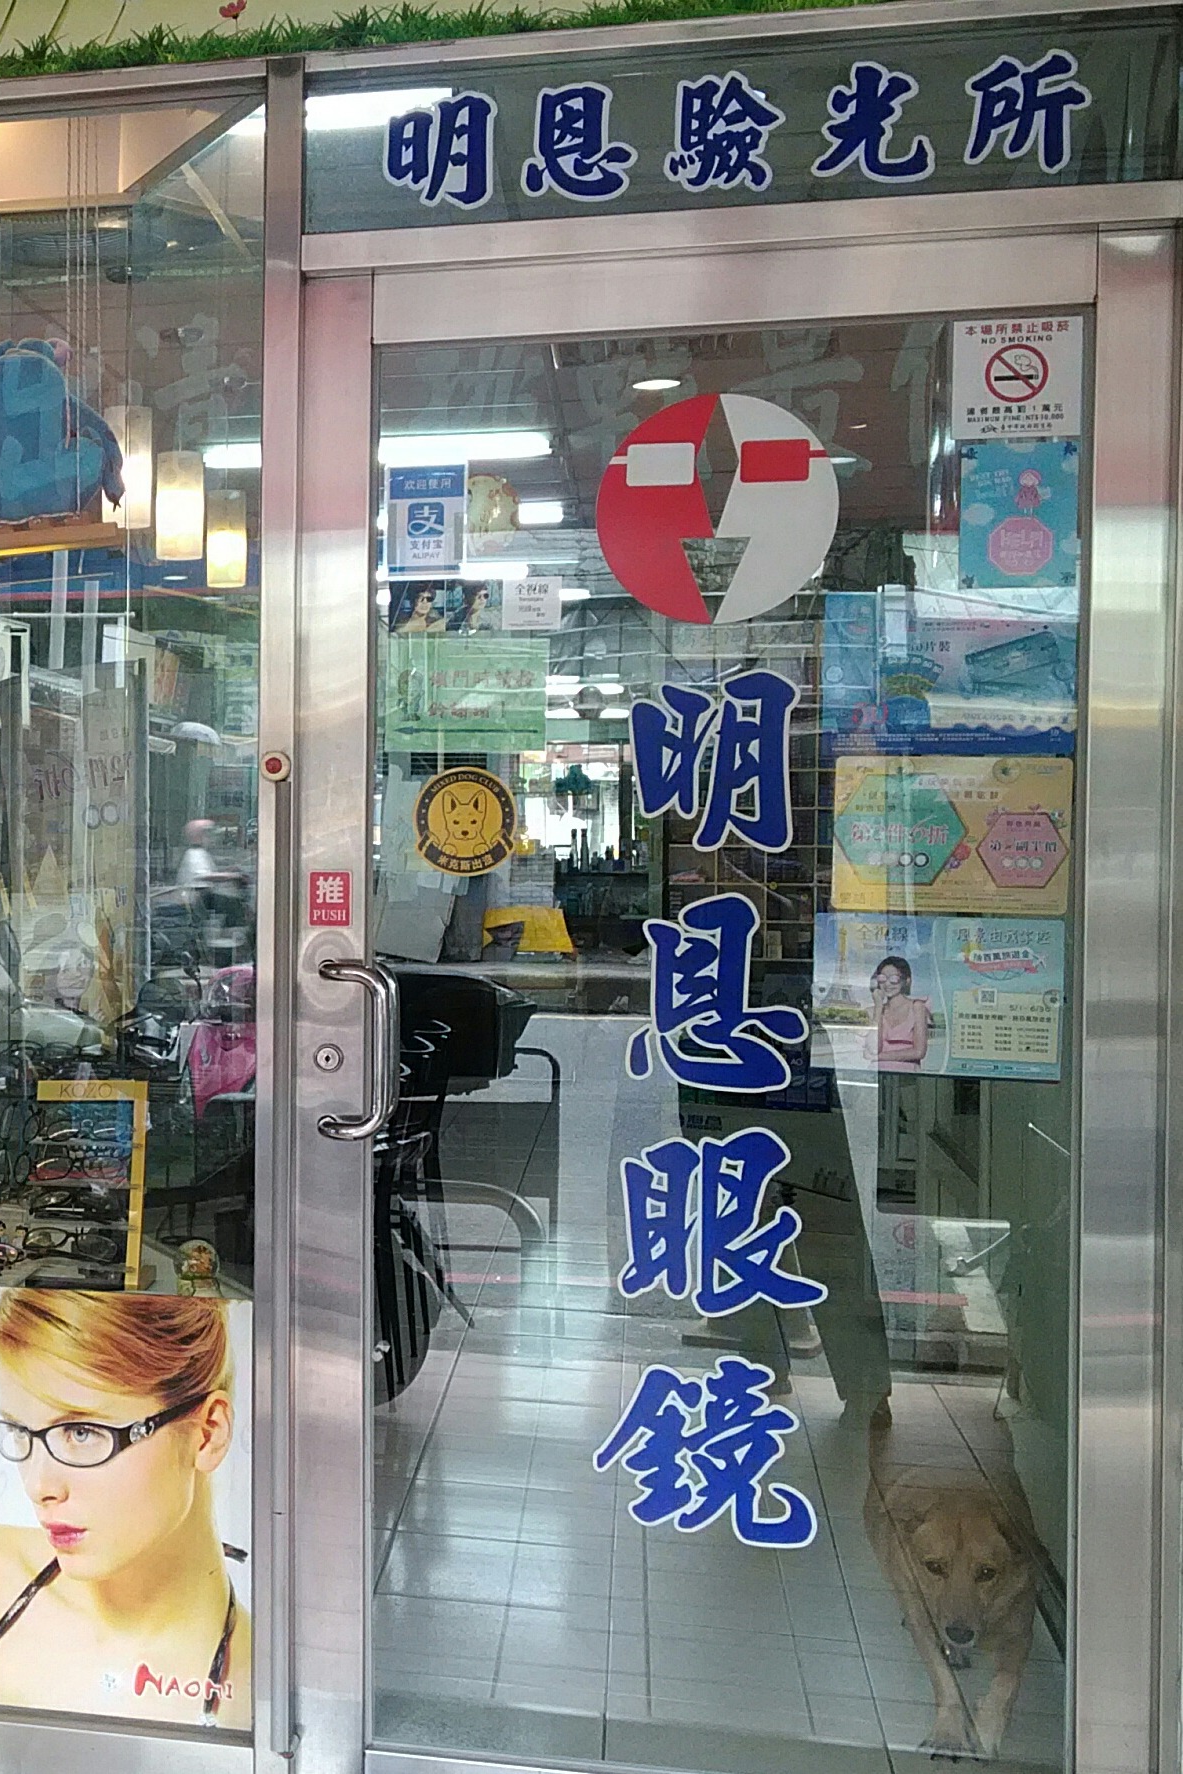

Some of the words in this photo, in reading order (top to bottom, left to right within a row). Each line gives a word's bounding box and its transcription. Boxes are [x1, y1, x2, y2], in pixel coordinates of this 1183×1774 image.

[383, 49, 1091, 209] 明恩驗光所
[965, 320, 1070, 336] 本場所禁止吸菸
[1001, 335, 1053, 344] SMOKING
[404, 478, 452, 490] 欢迎使用
[410, 538, 443, 551] 支付宝
[412, 552, 441, 560] ALIPAY
[430, 775, 457, 793] MIXED
[458, 773, 478, 781] DOG
[478, 777, 501, 793] CLUB
[315, 875, 345, 905] 推
[312, 909, 346, 921] PUSH
[59, 1081, 113, 1098] KOZO
[592, 671, 828, 1549] 明恩眼鏡
[133, 1662, 234, 1700] NAOMI
